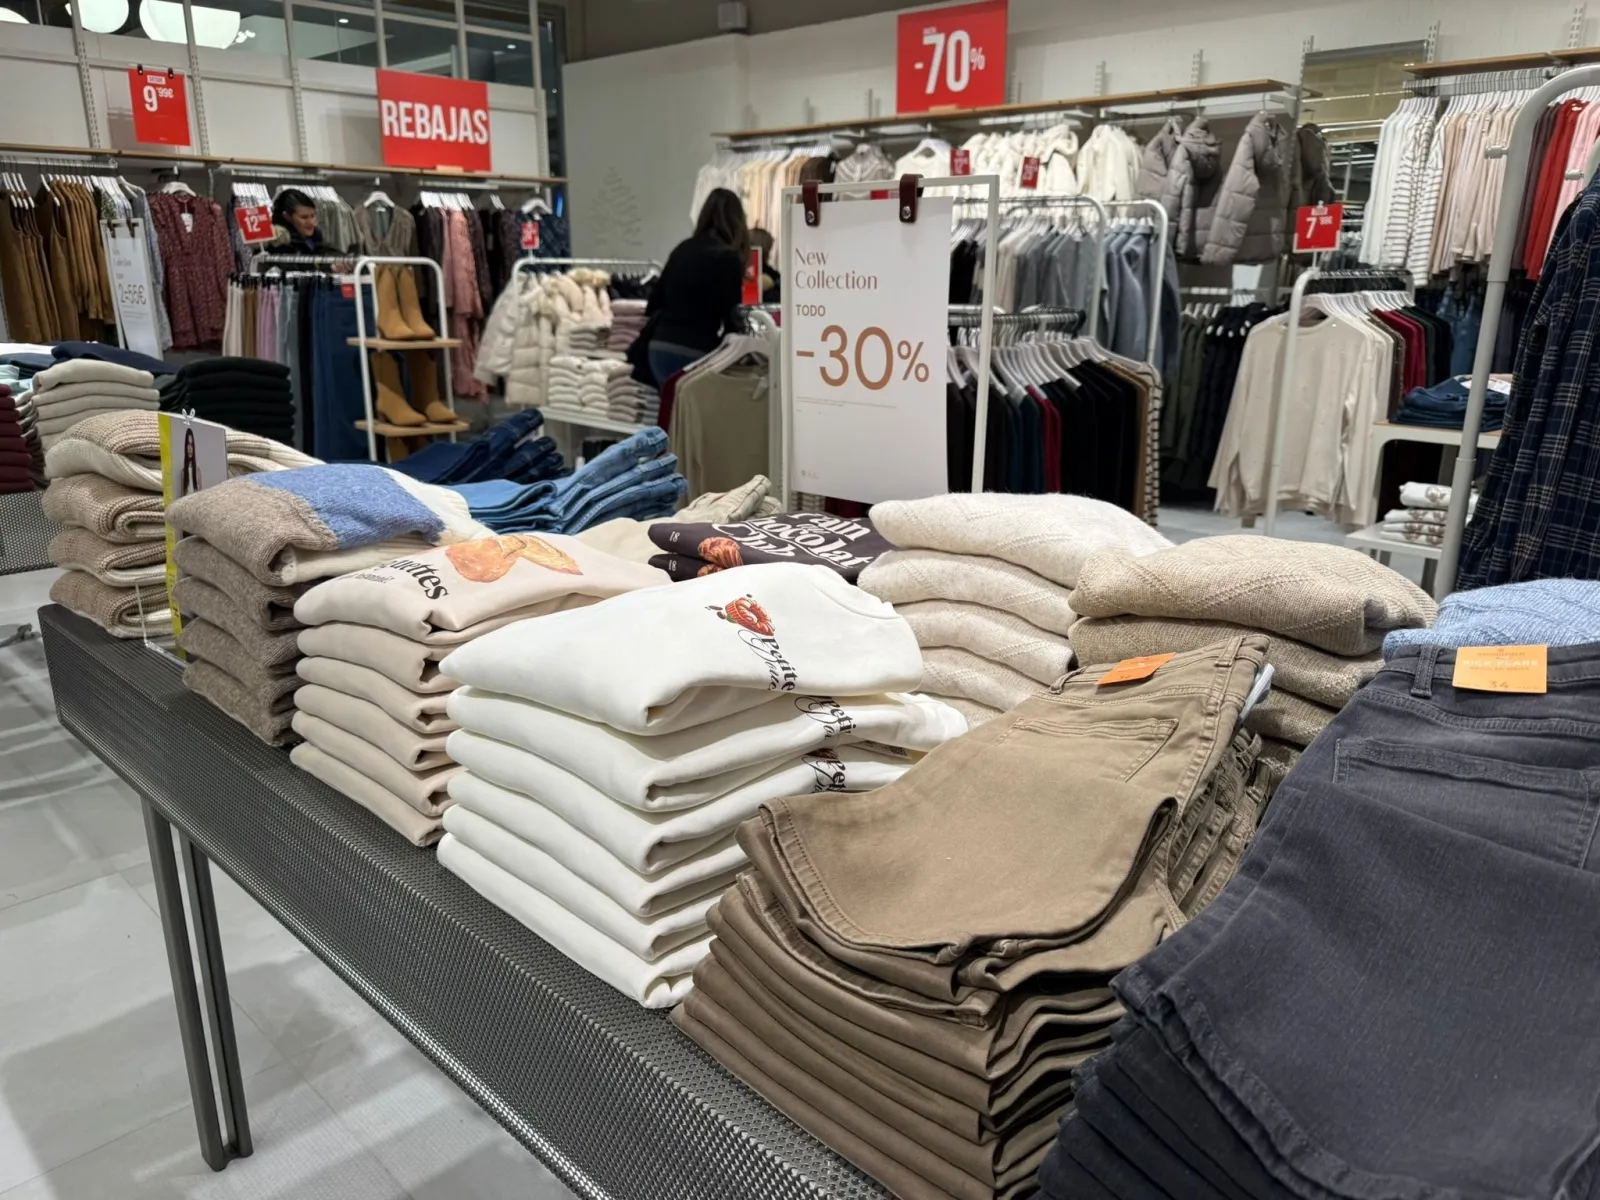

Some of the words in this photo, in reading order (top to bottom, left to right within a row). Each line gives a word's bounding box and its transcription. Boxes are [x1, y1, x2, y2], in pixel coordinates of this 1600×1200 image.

[914, 29, 985, 95] -70%
[381, 99, 488, 145] REBAJAS
[795, 247, 829, 266] New
[795, 270, 878, 290] Collection
[795, 304, 826, 317] TODO
[796, 324, 930, 391] -30%
[760, 638, 798, 691] Petite
[820, 700, 856, 733] Peti
[825, 760, 847, 793] Pet
